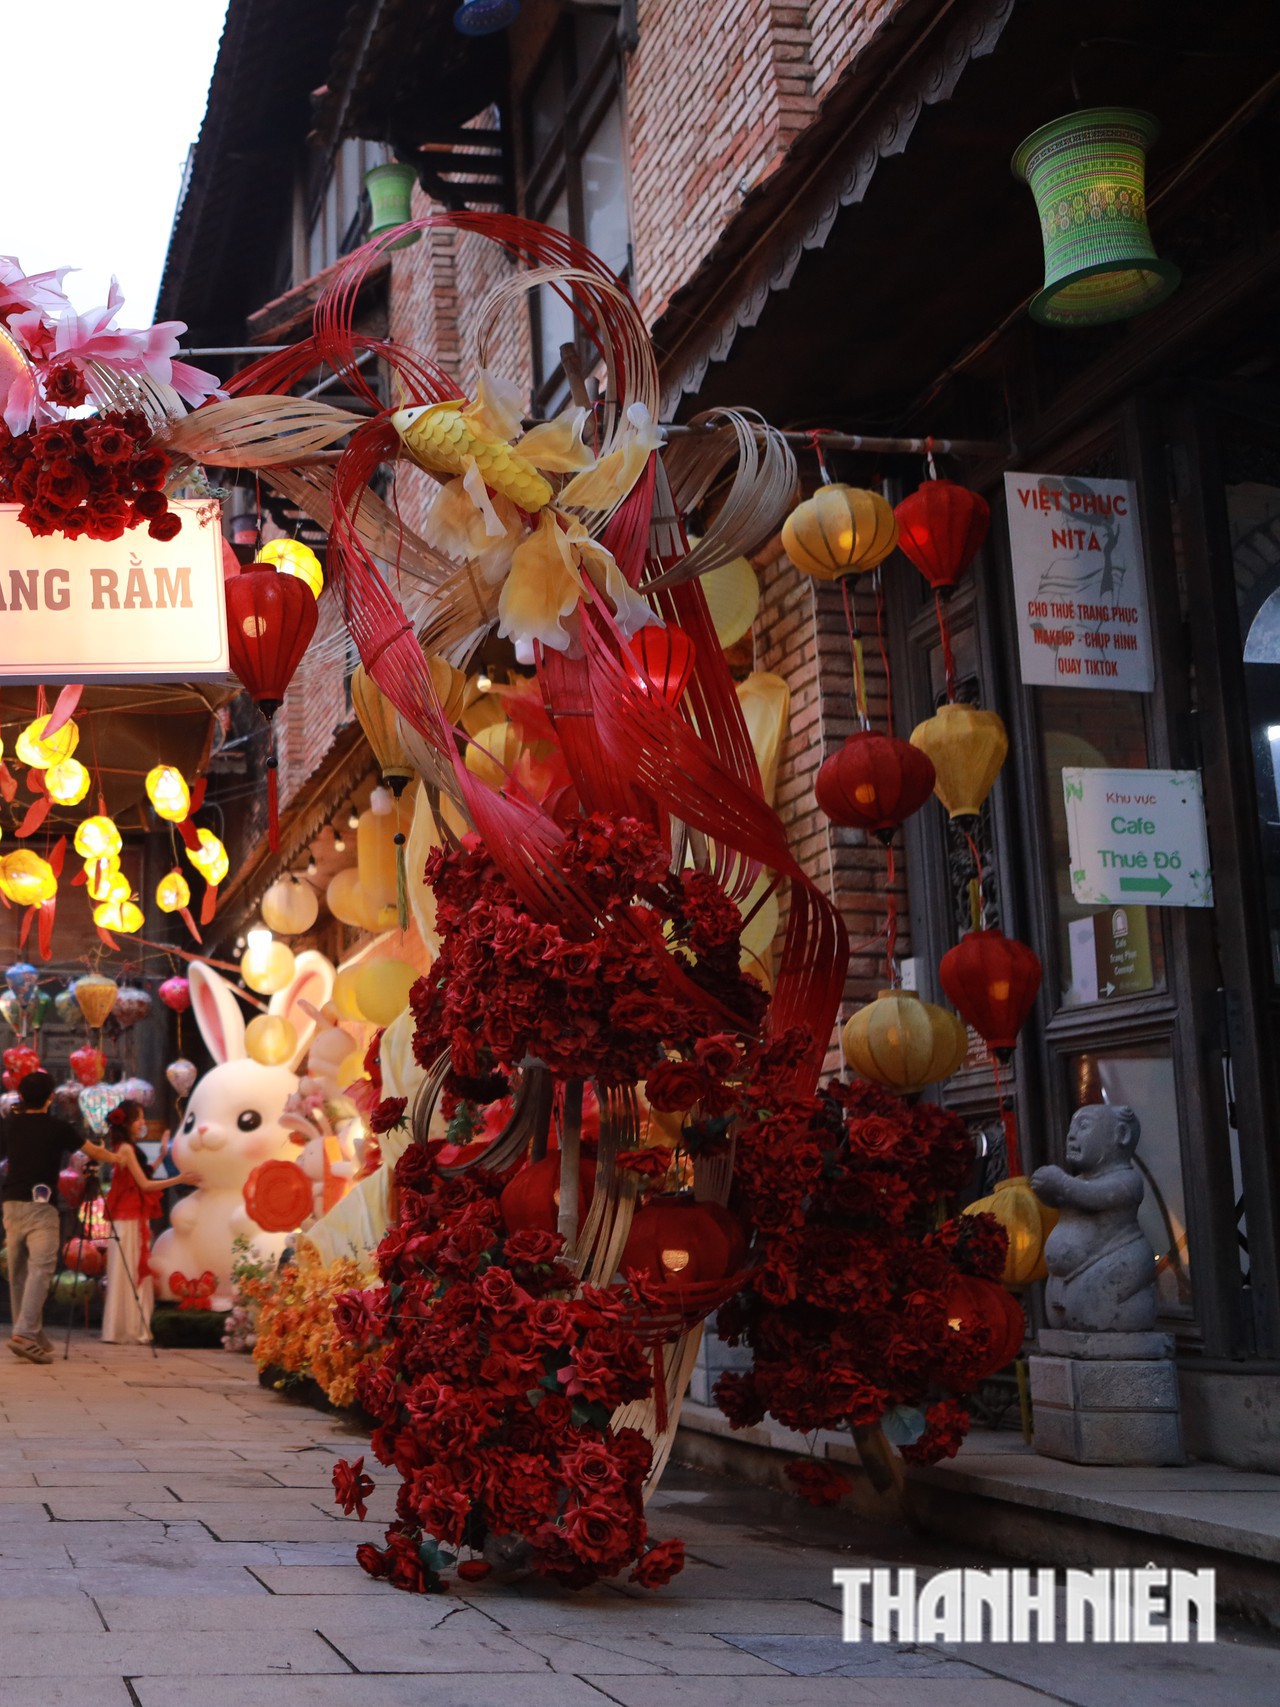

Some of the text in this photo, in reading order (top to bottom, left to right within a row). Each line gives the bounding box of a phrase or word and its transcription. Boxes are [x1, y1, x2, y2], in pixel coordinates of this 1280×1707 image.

[1017, 483, 1128, 520] VIỆT PHỤC
[1051, 528, 1102, 552] NITA
[90, 552, 194, 610] RẰM
[1028, 600, 1138, 626] CHO THUÊ TRANG PHỤC
[1033, 627, 1075, 647] MAKEUP
[1085, 631, 1111, 649] CHỤP
[1113, 630, 1138, 650] HÌNH
[1057, 657, 1119, 677] QUAY TIKTOK
[1106, 792, 1131, 805] Khu
[1110, 815, 1156, 835] Cafe
[1097, 850, 1148, 869] Thuê
